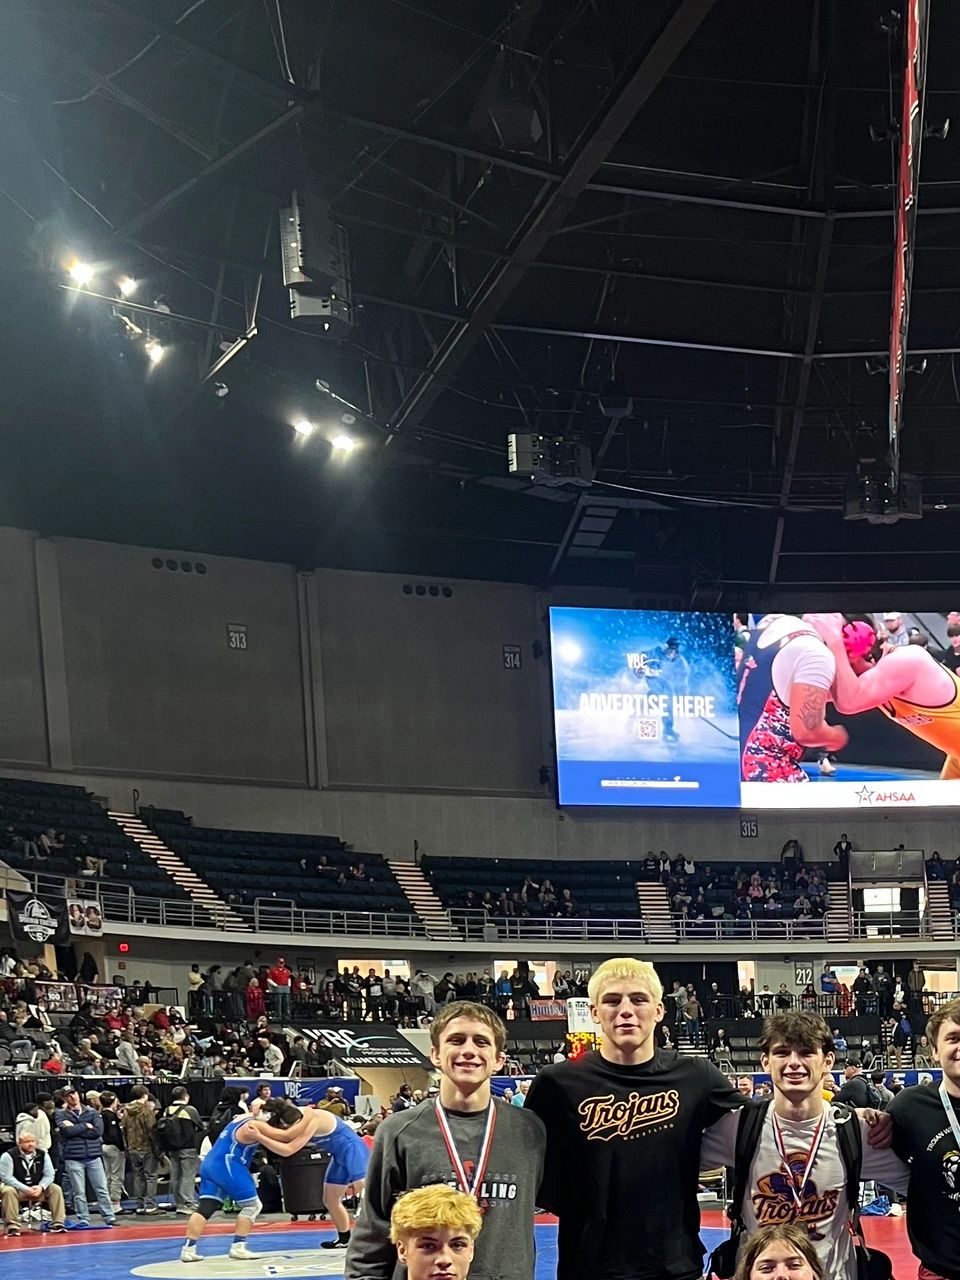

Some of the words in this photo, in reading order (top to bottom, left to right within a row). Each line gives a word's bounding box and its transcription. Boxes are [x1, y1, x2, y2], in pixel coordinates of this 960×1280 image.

[229, 632, 247, 649] 313
[504, 653, 520, 668] 314
[578, 692, 670, 717] ADVERTISE
[673, 696, 716, 719] HERE
[875, 791, 916, 801] AHSAA
[741, 821, 757, 836] 315
[796, 968, 812, 985] 212
[303, 1028, 370, 1049] VBC
[285, 1081, 302, 1098] VBC
[578, 1089, 680, 1136] Trojans
[622, 1123, 674, 1140] WRESTLING
[926, 1131, 945, 1152] TROJAN
